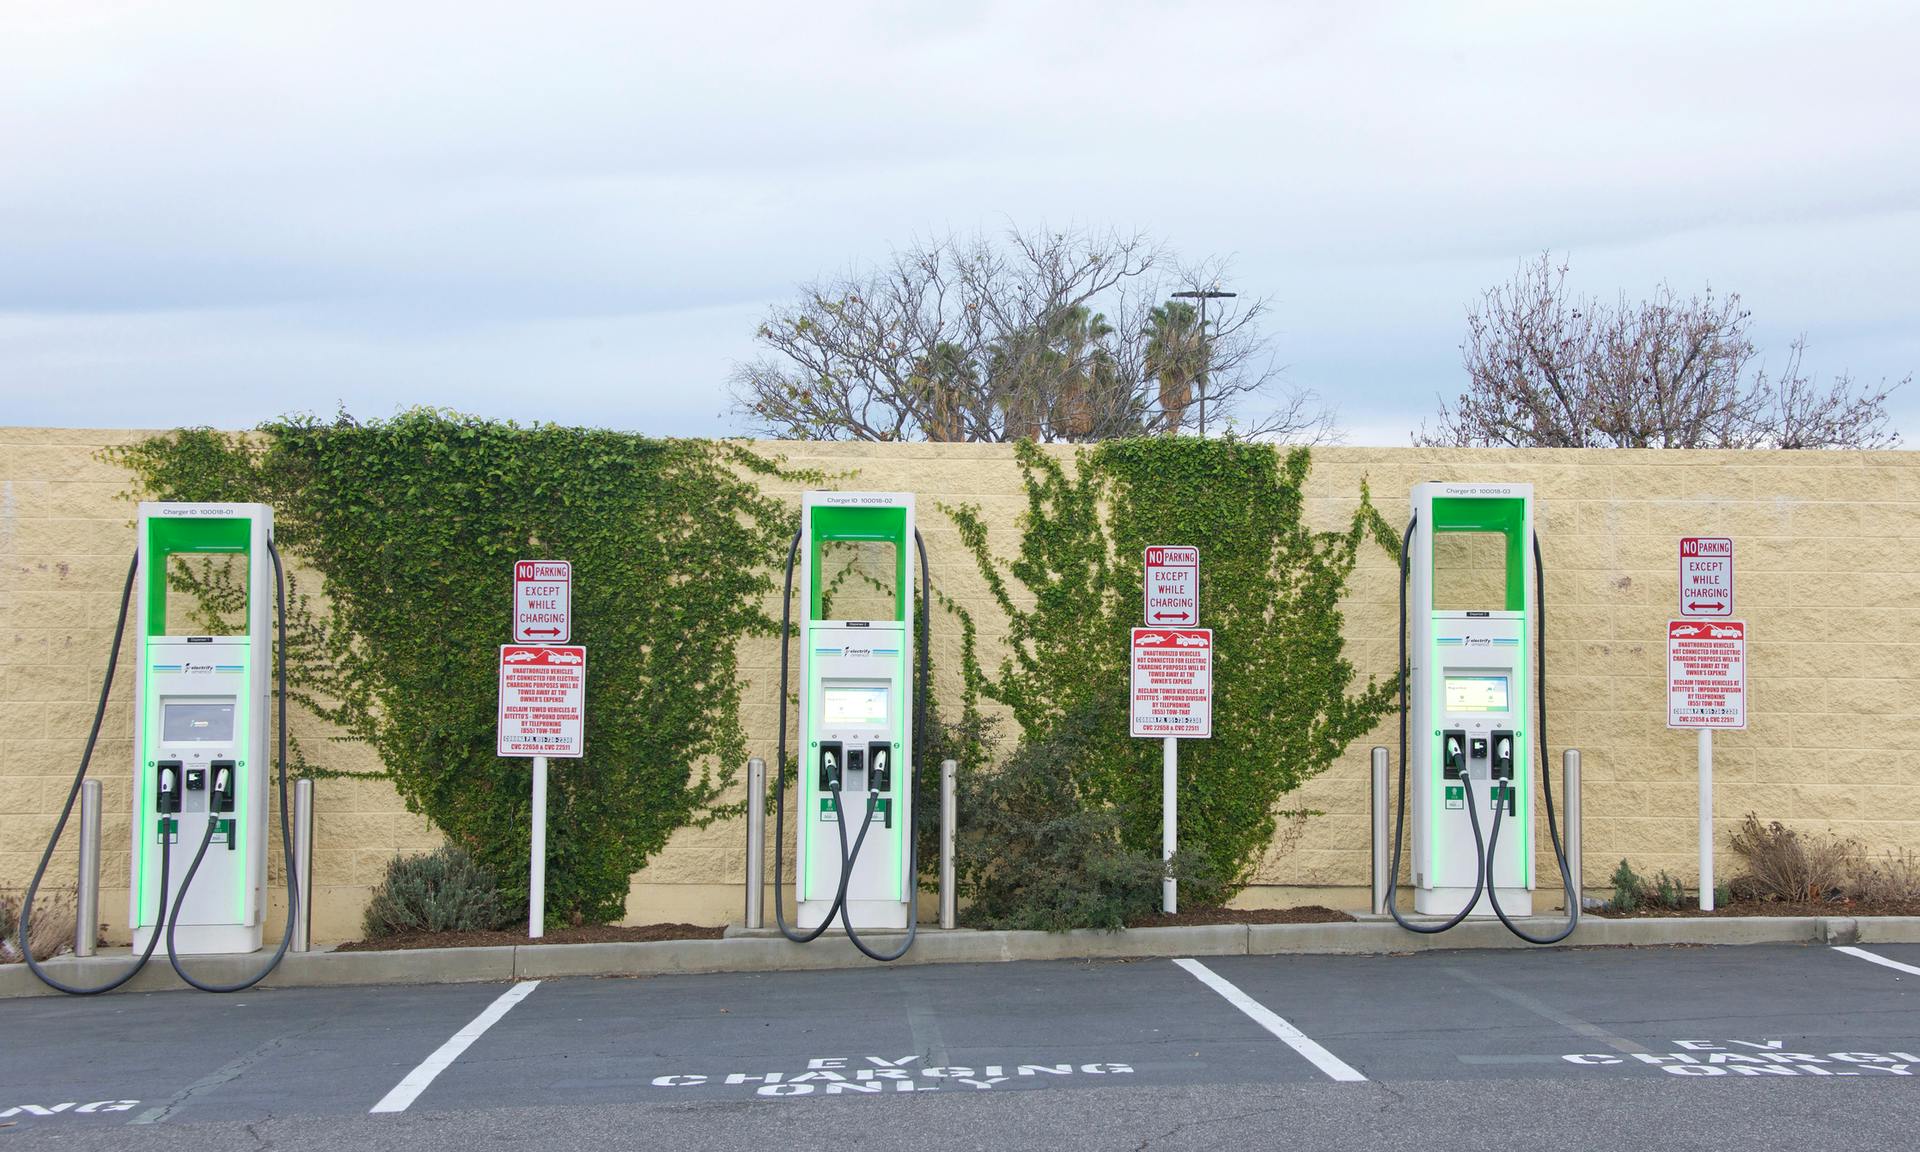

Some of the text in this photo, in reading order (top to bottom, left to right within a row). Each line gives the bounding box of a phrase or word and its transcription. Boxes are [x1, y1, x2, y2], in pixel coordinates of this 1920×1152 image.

[1684, 542, 1729, 553] NO PARKING
[1150, 551, 1194, 563] NO PARKING
[1690, 562, 1722, 571] EXCEPT
[520, 566, 566, 578] NO PARKING
[1156, 572, 1188, 580] EXCEPT
[1693, 576, 1719, 584] WHILE
[526, 587, 560, 596] EXCEPT
[1159, 585, 1184, 594] WHILE
[1685, 589, 1728, 597] CHARGING
[529, 600, 556, 609] WHILE
[1150, 599, 1192, 607] CHARGING
[520, 614, 564, 622] CHARGING
[1672, 1040, 1782, 1049] EV
[807, 1056, 920, 1070] EV
[1662, 1064, 1912, 1076] ONLY
[651, 1063, 1134, 1087] CHARGING
[756, 1077, 1010, 1096] ONLY
